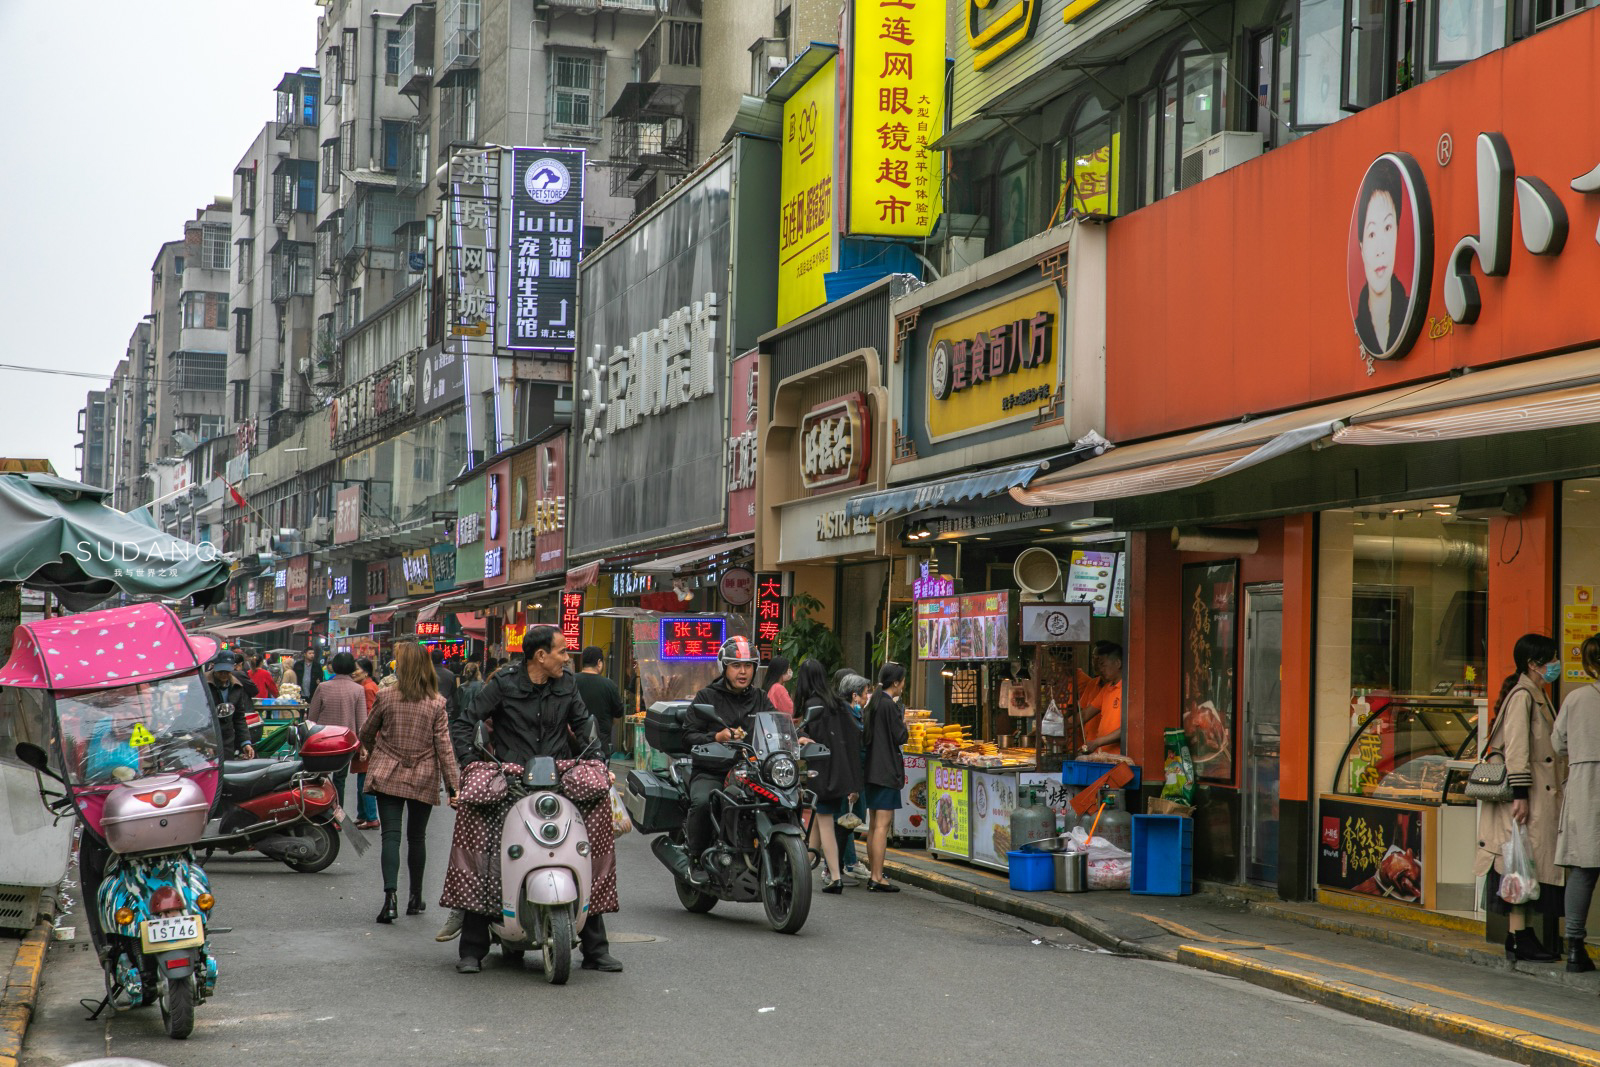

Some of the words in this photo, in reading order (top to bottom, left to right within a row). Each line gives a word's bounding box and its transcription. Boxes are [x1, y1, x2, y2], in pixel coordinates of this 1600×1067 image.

[915, 95, 931, 227] 大型自选式平价体验店
[532, 189, 543, 198] PET
[543, 189, 563, 199] STORE
[519, 210, 543, 232] iu
[549, 211, 574, 233] iu
[549, 237, 572, 278] 猫咖
[516, 236, 540, 338] 宠物生活馆
[541, 329, 575, 338] 请上二楼
[563, 593, 581, 651] 精品坚果
[673, 622, 713, 638] 张记
